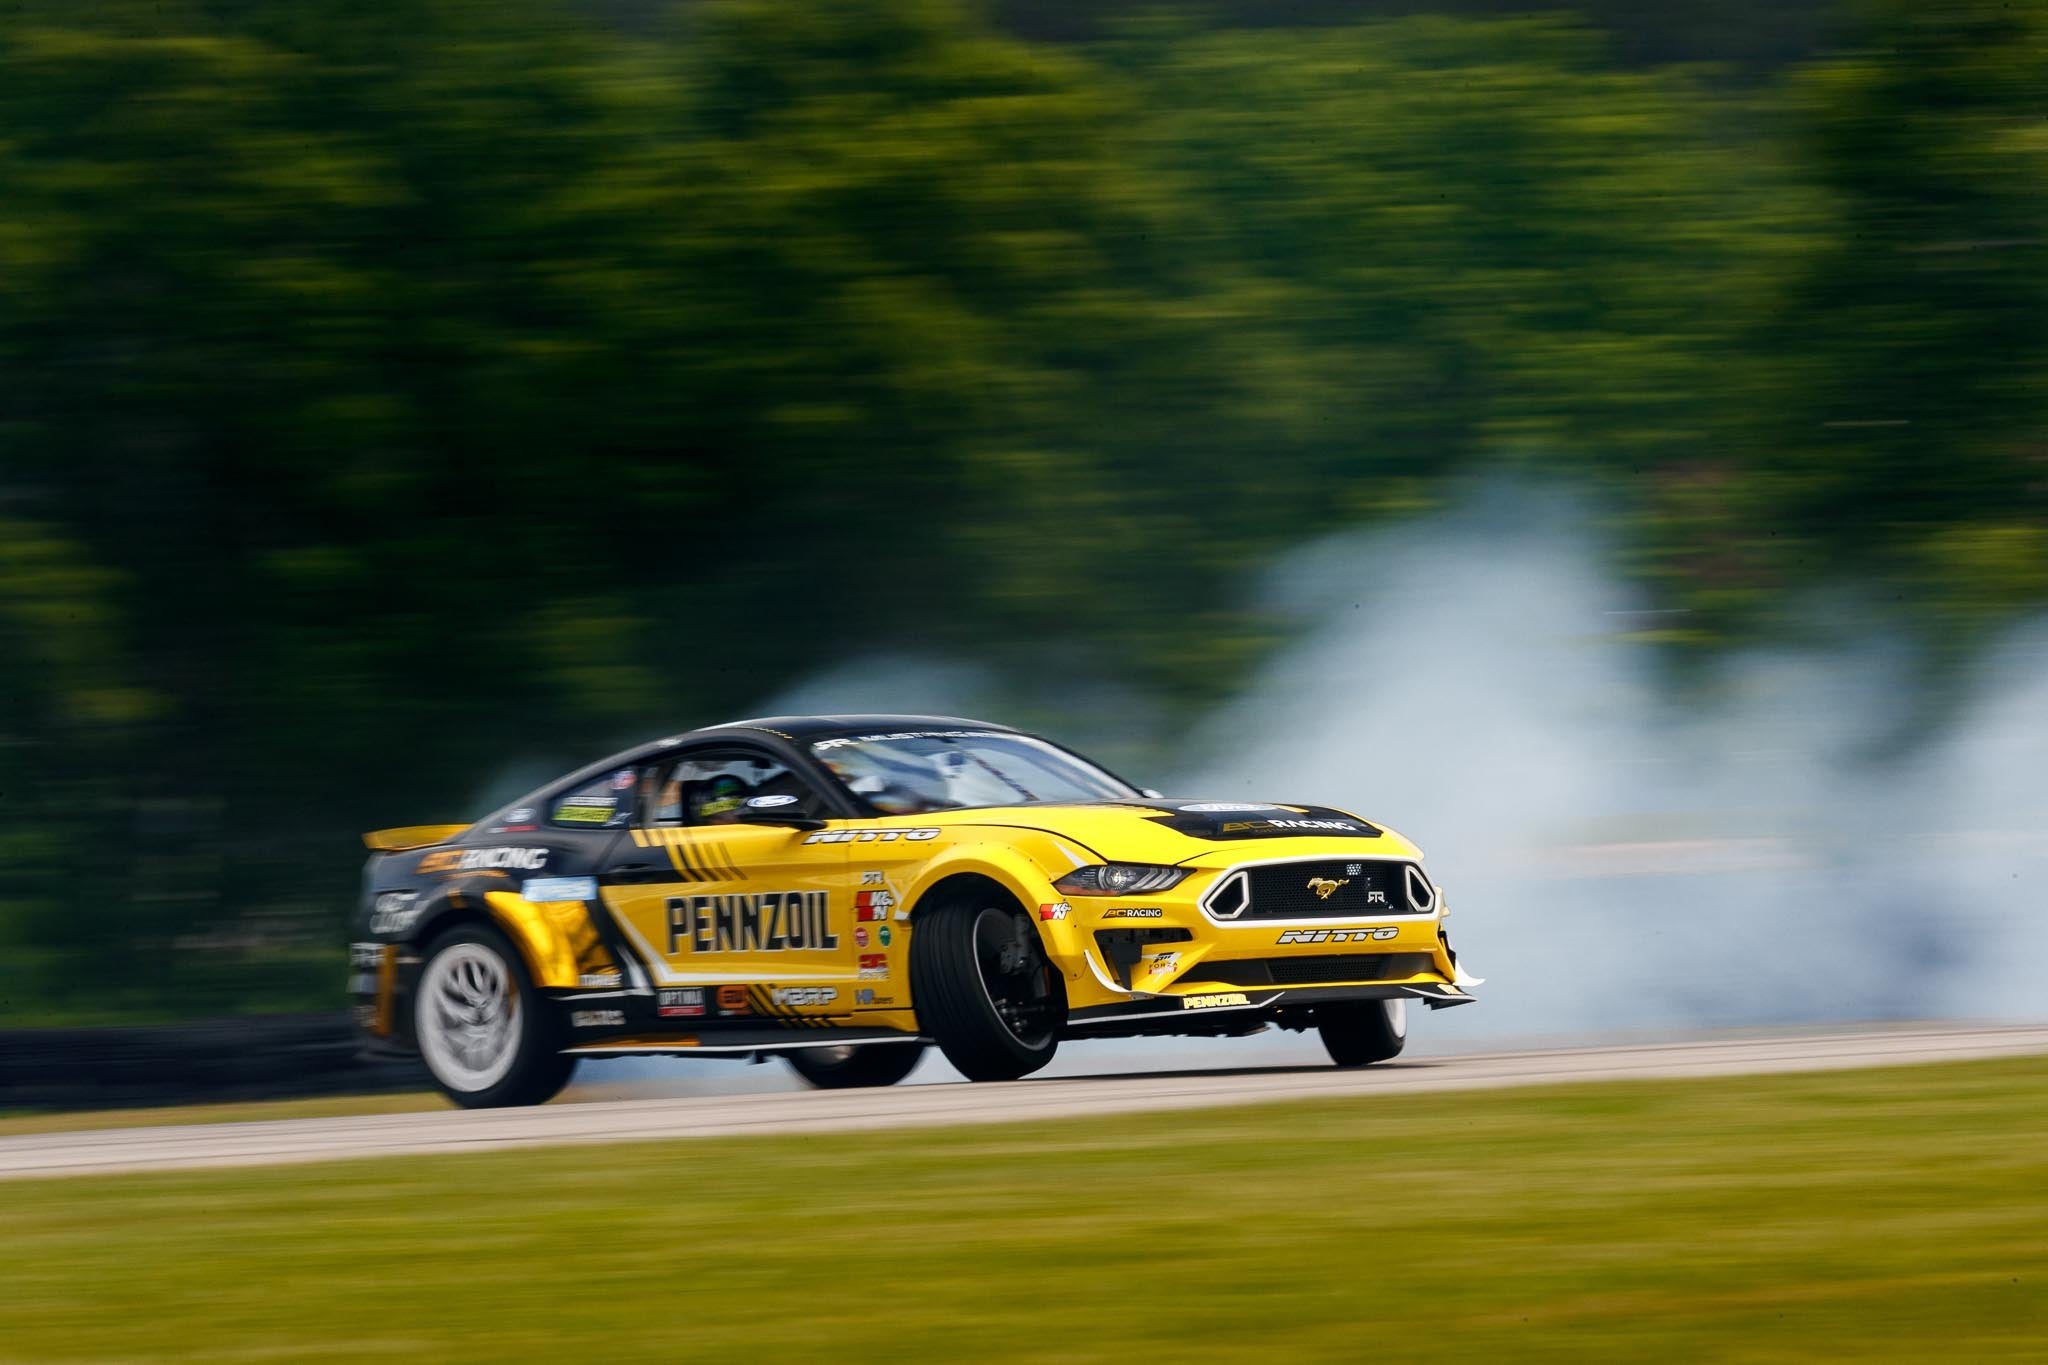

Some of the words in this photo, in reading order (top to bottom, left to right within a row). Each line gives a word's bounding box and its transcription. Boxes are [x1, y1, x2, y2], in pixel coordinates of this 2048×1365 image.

[801, 828, 941, 845] NITTO
[665, 890, 840, 955] PENNZOIL
[1276, 927, 1399, 944] NITTO
[1183, 993, 1250, 1010] PENNZOIL
